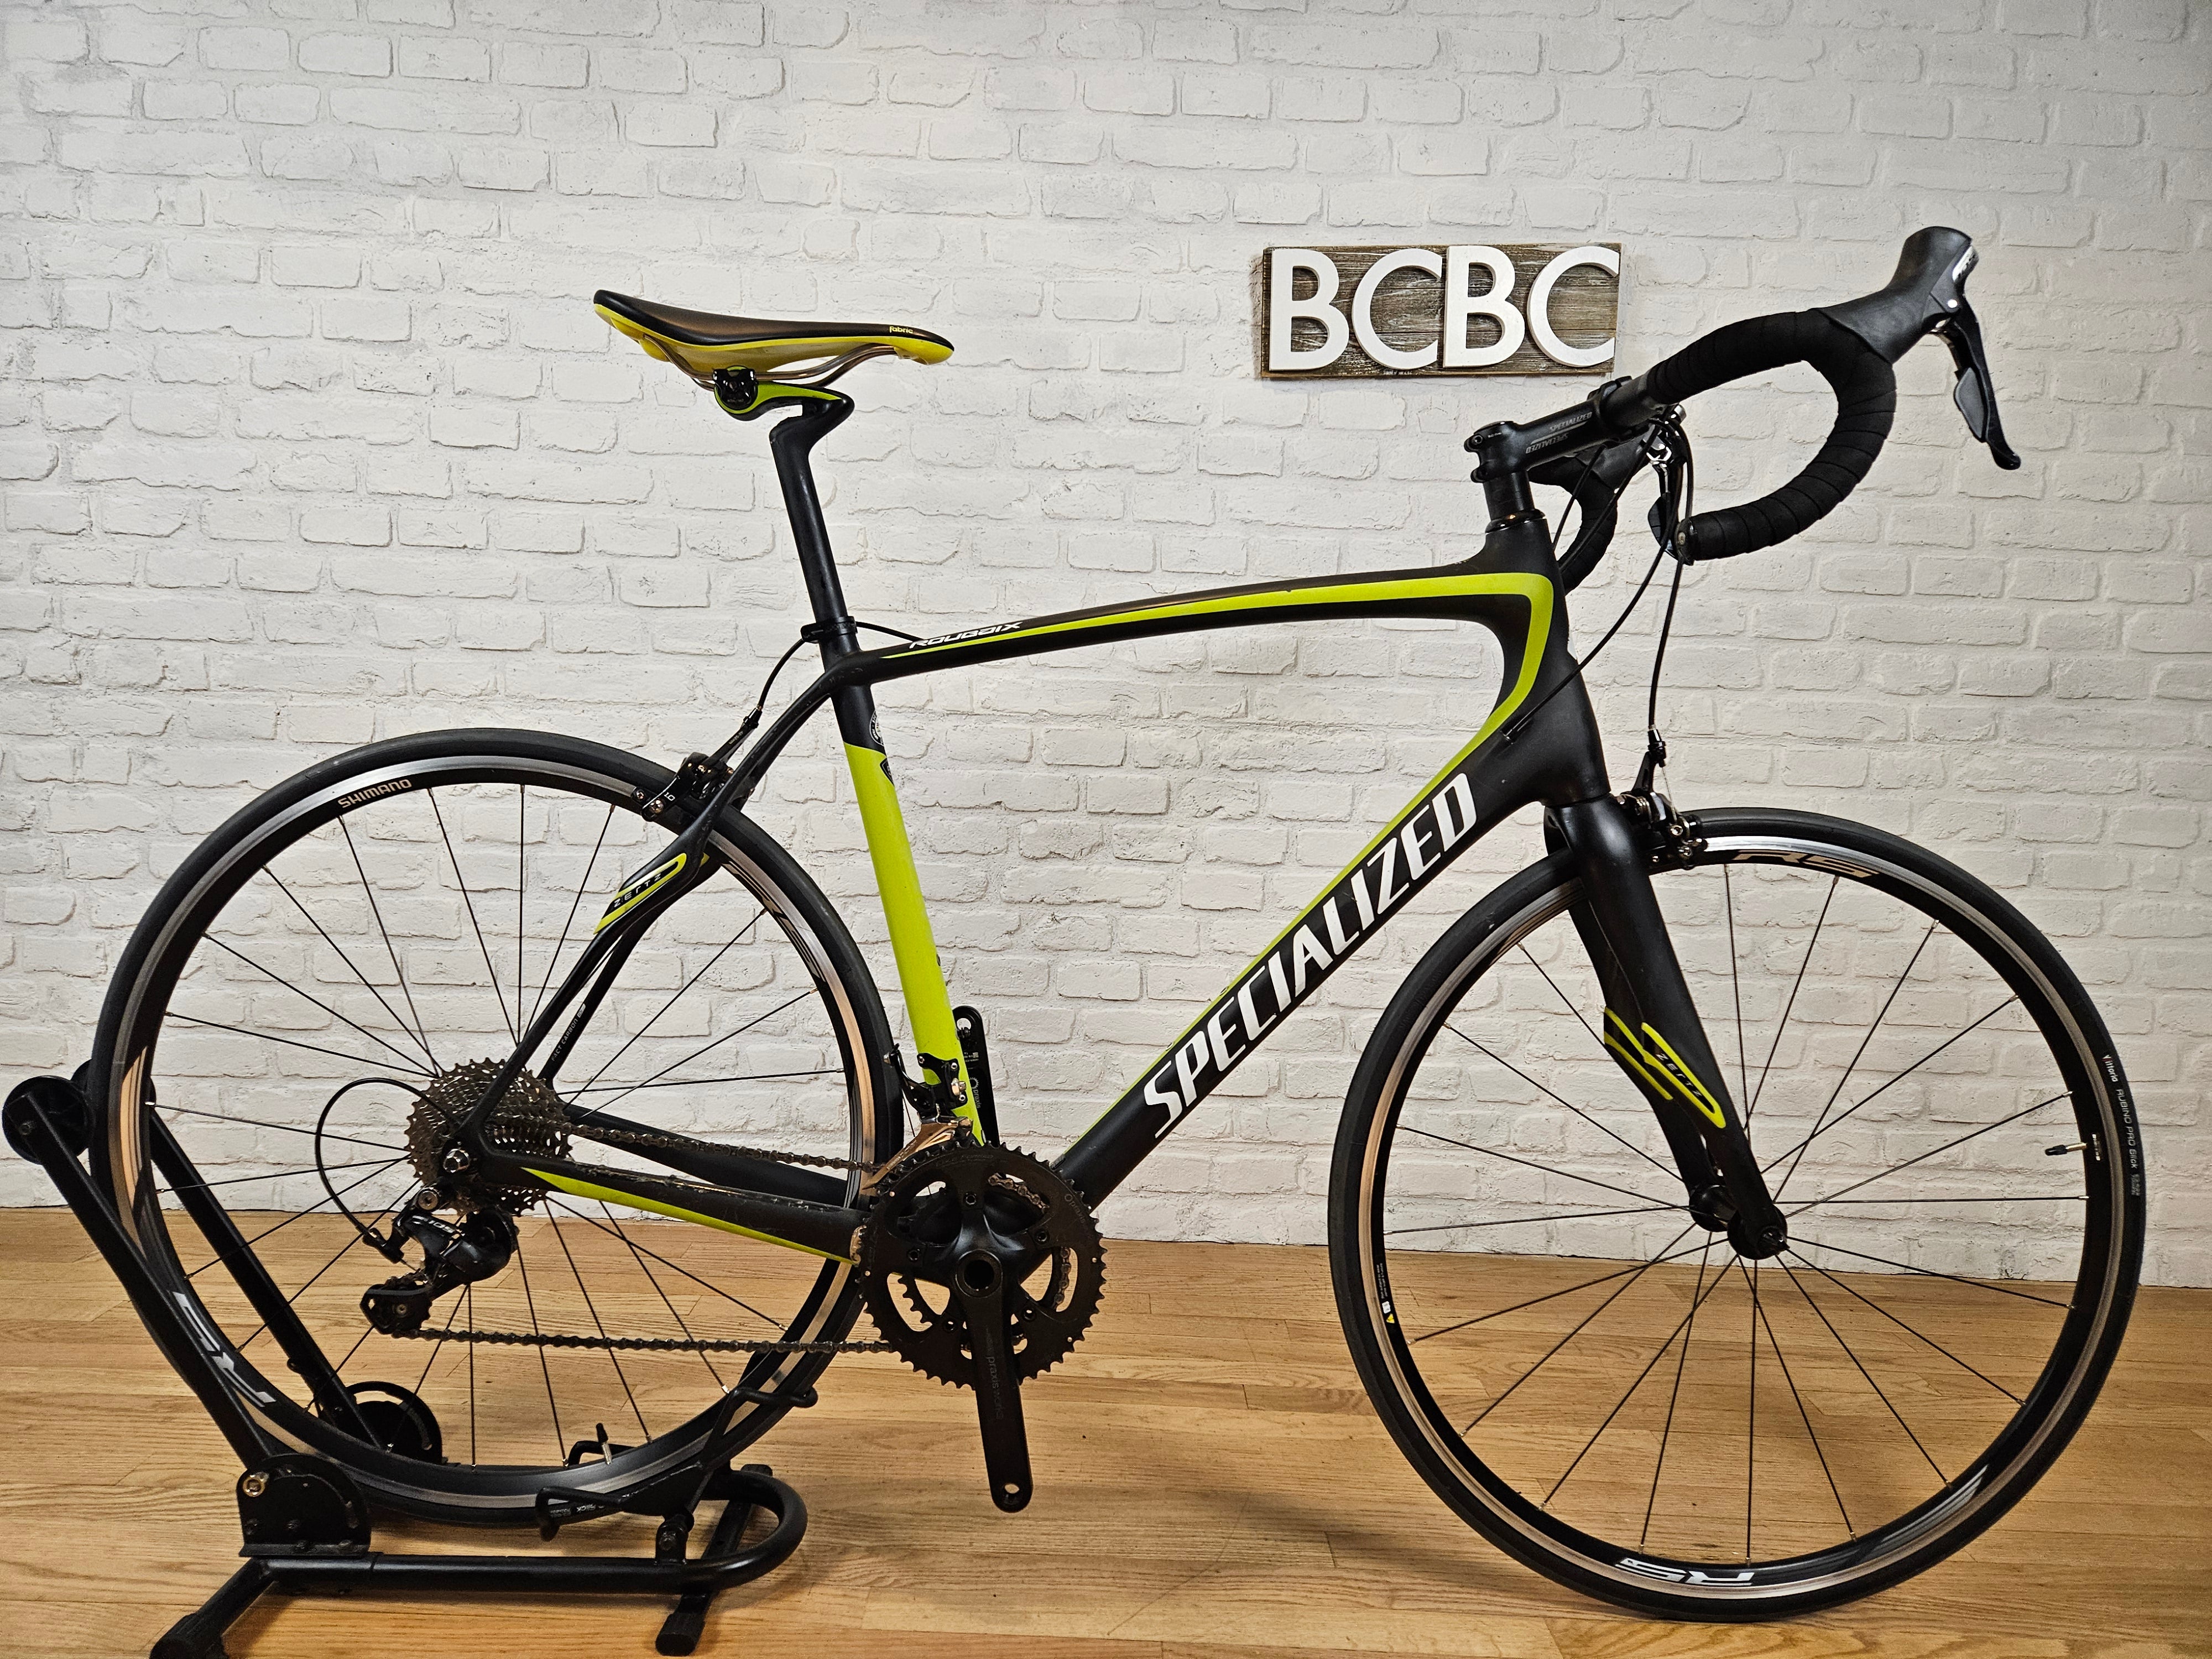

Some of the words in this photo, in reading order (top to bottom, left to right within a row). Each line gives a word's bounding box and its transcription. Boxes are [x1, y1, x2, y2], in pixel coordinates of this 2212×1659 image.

[1269, 245, 1620, 371] BCBC
[909, 622, 1022, 649] ROUBAIX
[337, 779, 412, 808] SHIMANO
[1144, 773, 1477, 1139] SPECIALIZED
[551, 1045, 562, 1061] FACT
[561, 1018, 578, 1044] CARBON
[2102, 1055, 2119, 1082] Vittoria
[2116, 1089, 2132, 1124] RUBINO
[2125, 1126, 2136, 1146] PRO
[429, 1220, 455, 1233] 105
[986, 1356, 1000, 1389] praxis
